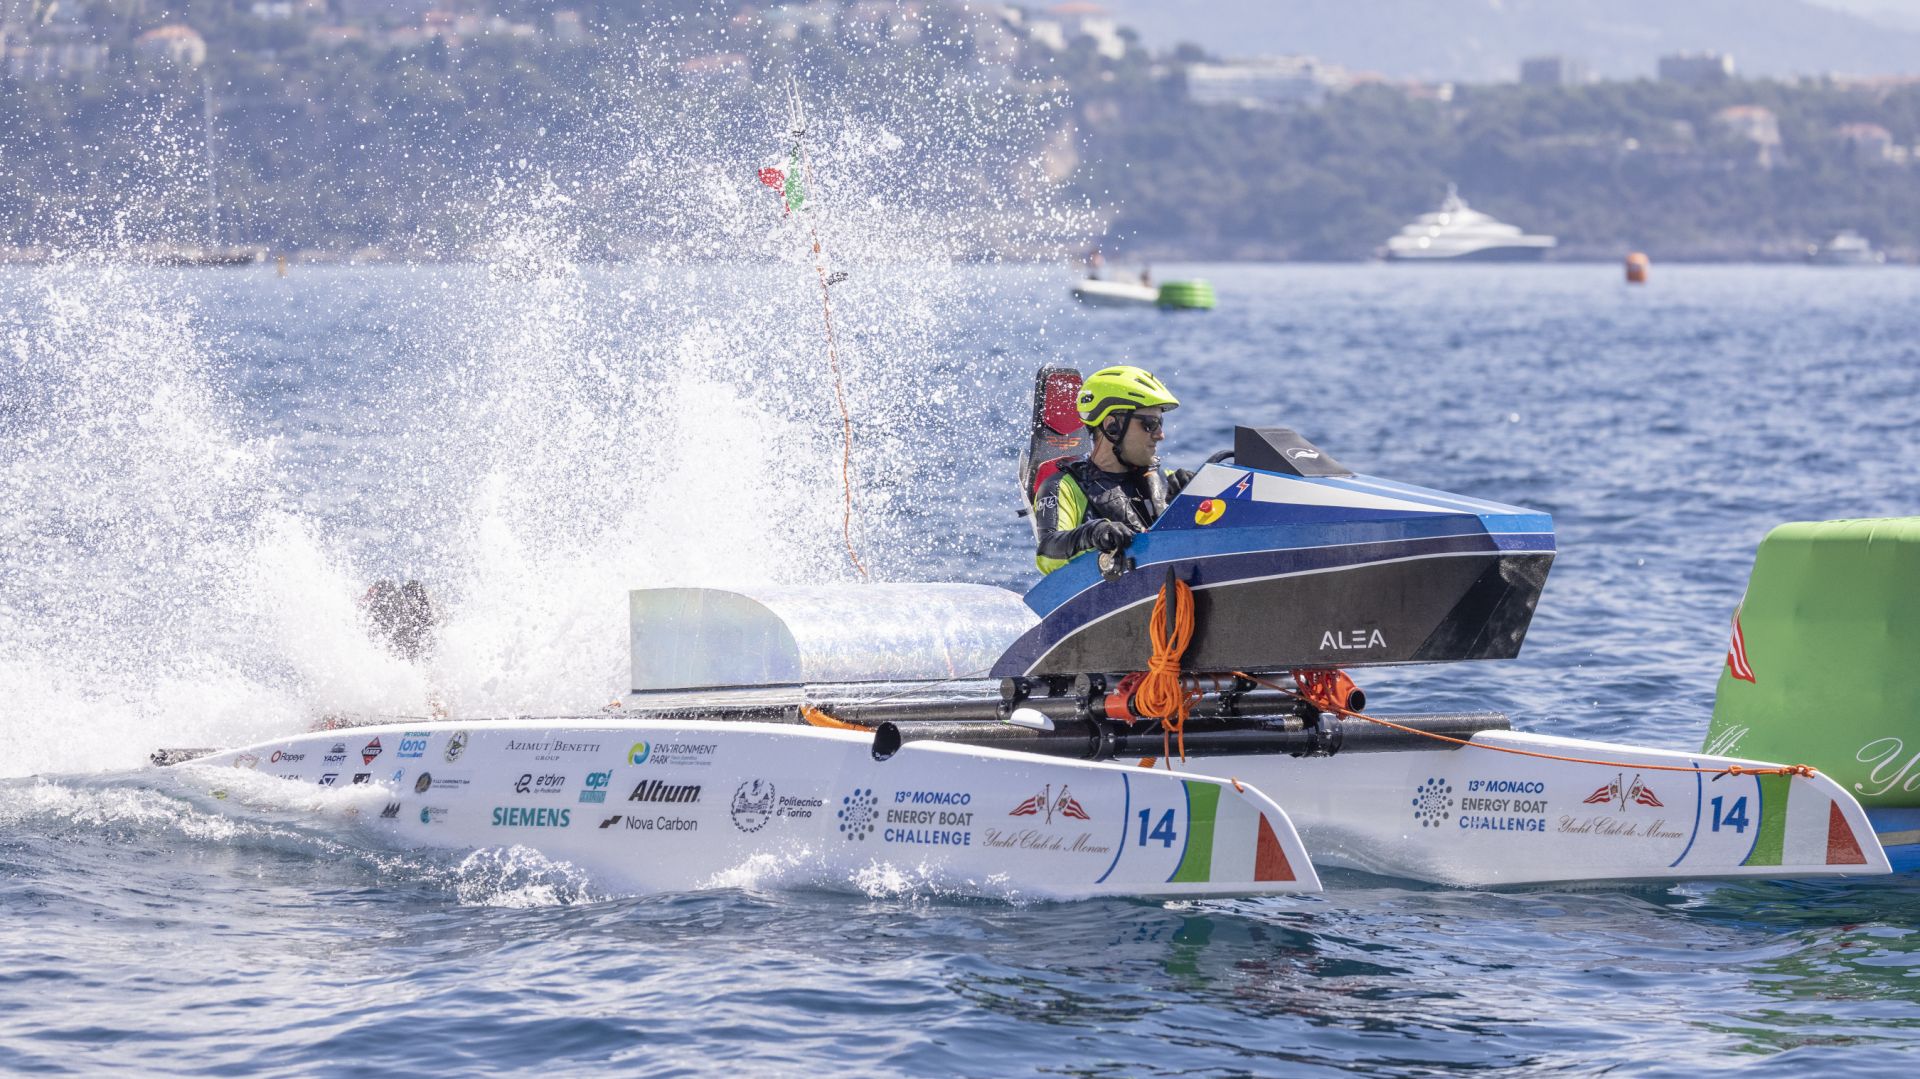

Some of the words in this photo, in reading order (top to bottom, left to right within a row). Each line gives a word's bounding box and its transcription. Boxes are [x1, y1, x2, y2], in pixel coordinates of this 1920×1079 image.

[1319, 629, 1387, 650] ALEA
[653, 743, 718, 755] ENVIRONMENT
[649, 754, 670, 764] PARK
[1485, 780, 1544, 794] MONACO
[779, 796, 823, 807] Politecnico
[912, 791, 971, 805] MONACO
[1461, 797, 1511, 812] ENERGY
[1513, 800, 1548, 813] BOAT
[492, 806, 571, 827] SIEMENS
[787, 807, 812, 818] Torino
[886, 809, 935, 824] ENERGY
[938, 811, 973, 826] BOAT
[1710, 795, 1749, 833] 14
[626, 815, 653, 830] Nova
[656, 816, 698, 831] Carbon
[1138, 808, 1177, 848] 14
[1459, 815, 1546, 832] CHALLENGE
[1557, 815, 1591, 834] Yacht
[1592, 816, 1623, 836] Club
[1622, 824, 1634, 837] de
[1637, 819, 1684, 839] Monaco
[884, 828, 971, 846] CHALLENGE
[983, 827, 1020, 848] Yacht
[1017, 828, 1049, 849] Club
[1049, 837, 1064, 851] de
[1064, 832, 1110, 854] Monaco
